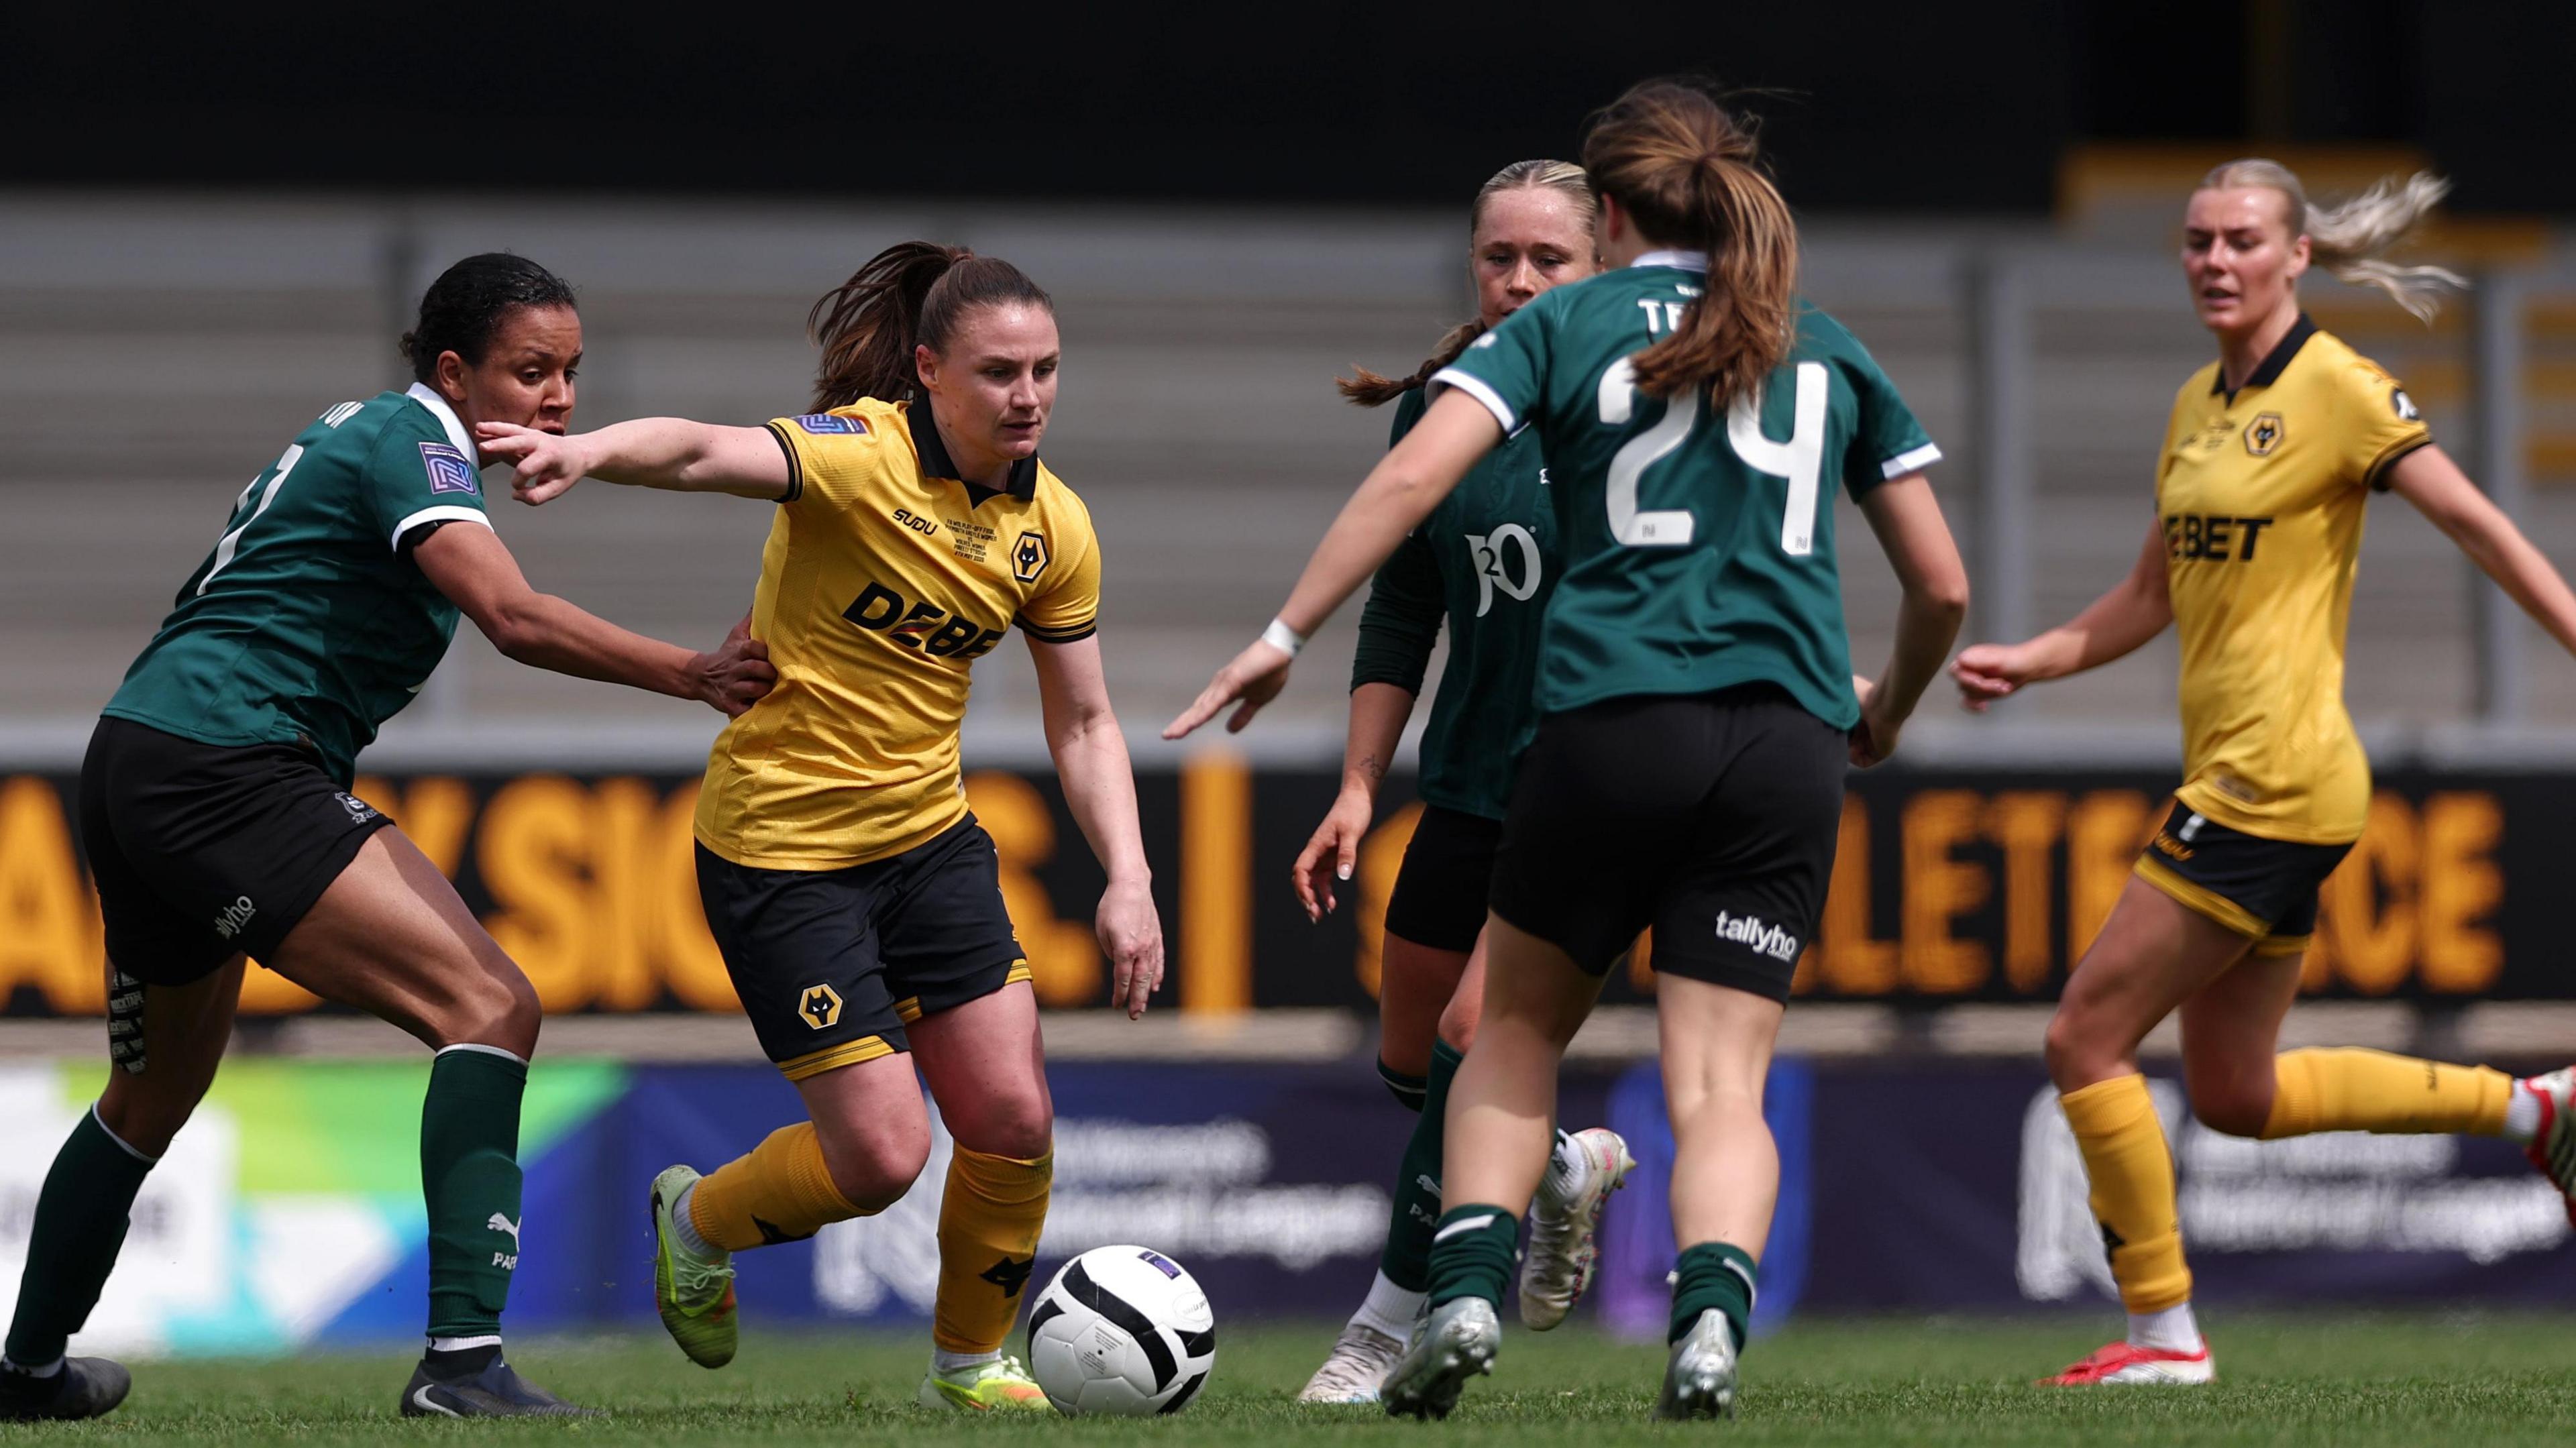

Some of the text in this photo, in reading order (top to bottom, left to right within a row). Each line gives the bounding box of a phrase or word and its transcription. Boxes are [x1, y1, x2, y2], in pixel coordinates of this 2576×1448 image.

[1599, 357, 1829, 555] 24
[892, 508, 938, 536] SUDU
[1716, 909, 1798, 954] tallyho
